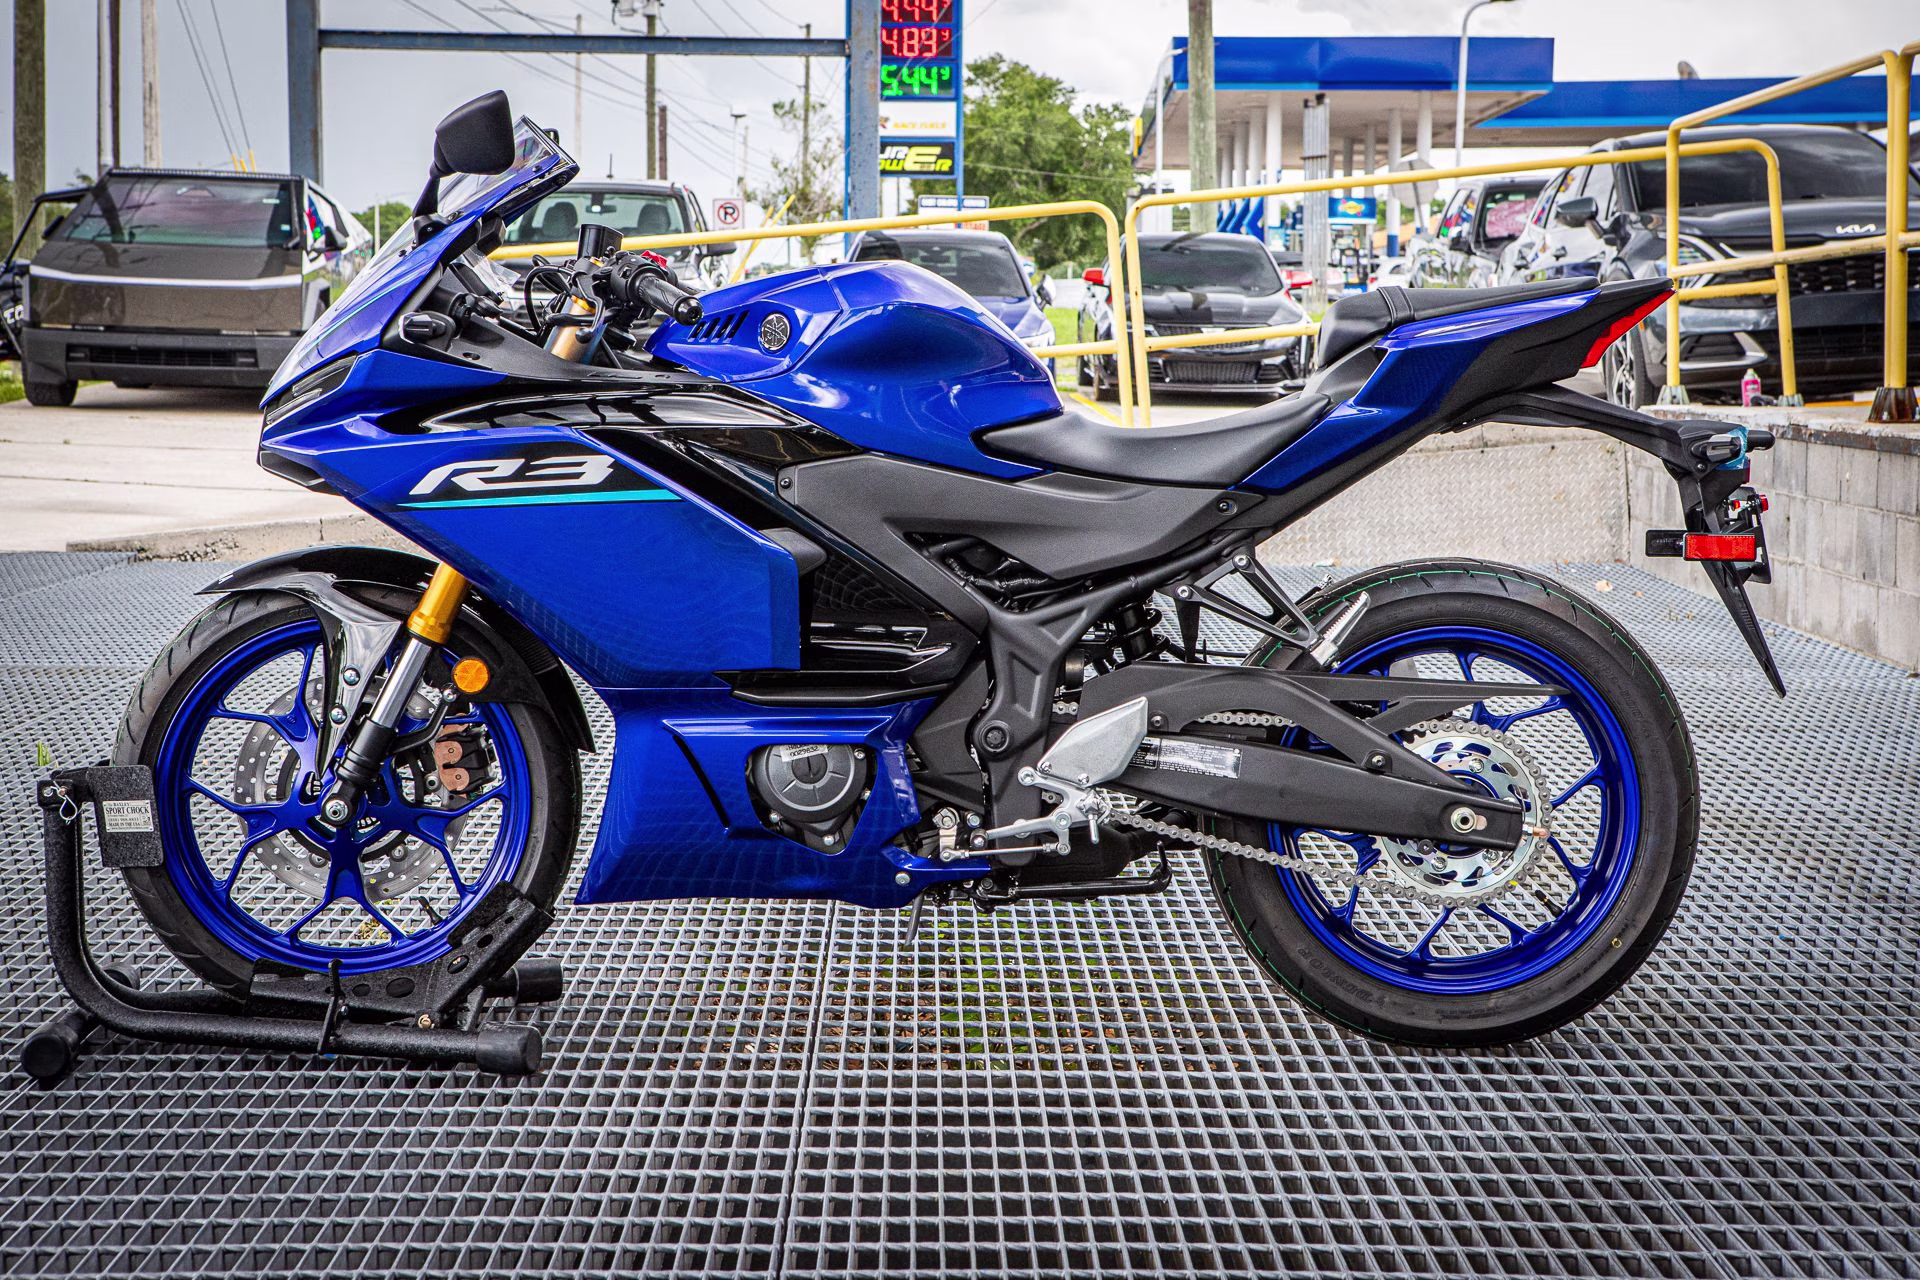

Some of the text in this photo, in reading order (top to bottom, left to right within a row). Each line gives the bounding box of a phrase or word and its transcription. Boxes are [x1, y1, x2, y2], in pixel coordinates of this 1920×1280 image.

[409, 454, 616, 495] R3
[105, 806, 150, 815] SPORT CHOCK
